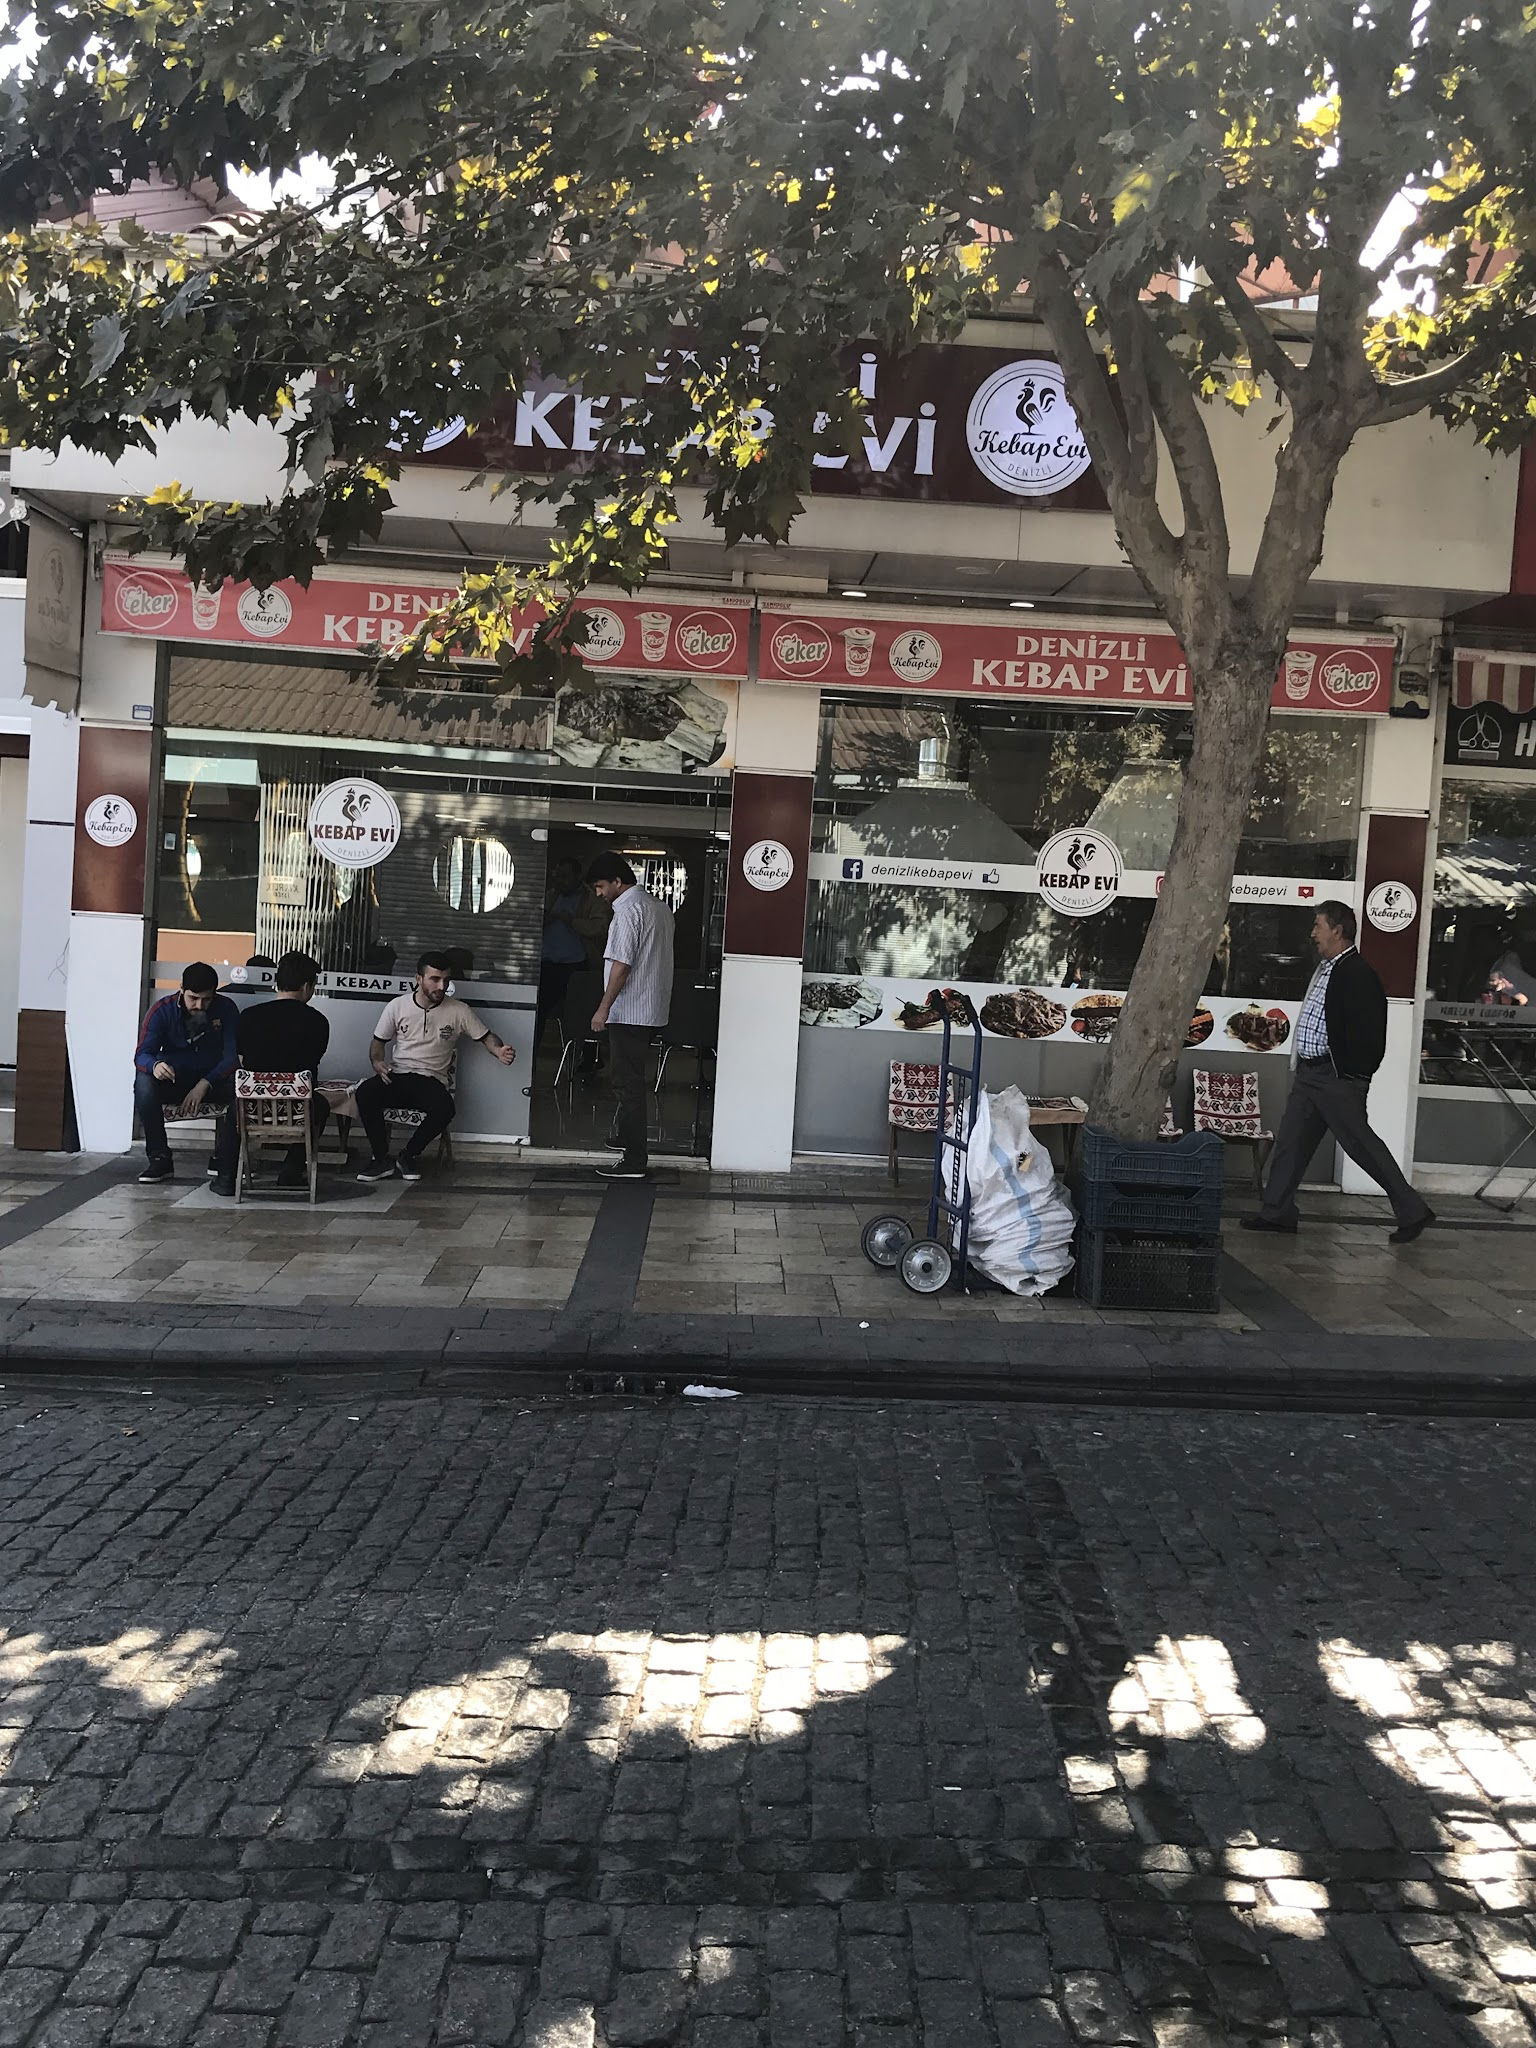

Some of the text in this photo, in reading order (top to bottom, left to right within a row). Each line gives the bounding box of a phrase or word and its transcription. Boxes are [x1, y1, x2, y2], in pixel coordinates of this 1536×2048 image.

[689, 630, 731, 653] eker
[785, 639, 827, 662] eker
[1016, 634, 1147, 662] DENİZLİ
[971, 658, 1188, 696] KEBAP EVİ
[1333, 670, 1375, 692] eker
[314, 823, 395, 843] KEBAP EVİ
[871, 864, 973, 881] denizlikebapevi
[1039, 872, 1118, 891] KEBAP EVİ
[336, 976, 392, 991] KEBAP
[399, 981, 419, 992] EV
